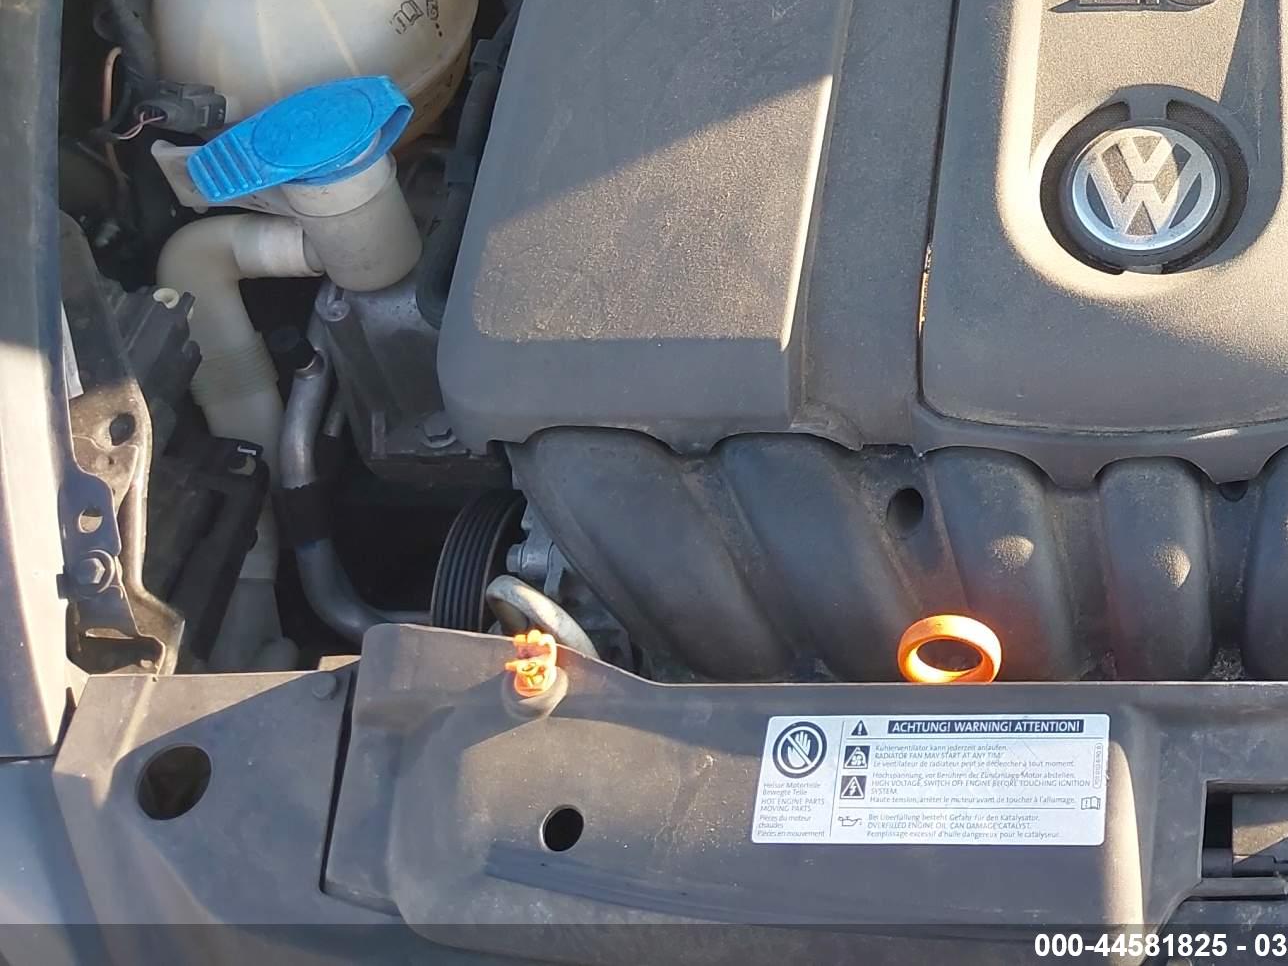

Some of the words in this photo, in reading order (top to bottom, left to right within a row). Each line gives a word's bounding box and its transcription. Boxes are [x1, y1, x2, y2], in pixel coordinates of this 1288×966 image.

[1077, 130, 1211, 246] VW
[891, 721, 950, 732] ACHTUNG!
[953, 721, 1012, 732] WARNING!
[1014, 721, 1080, 732] ATTENTION!
